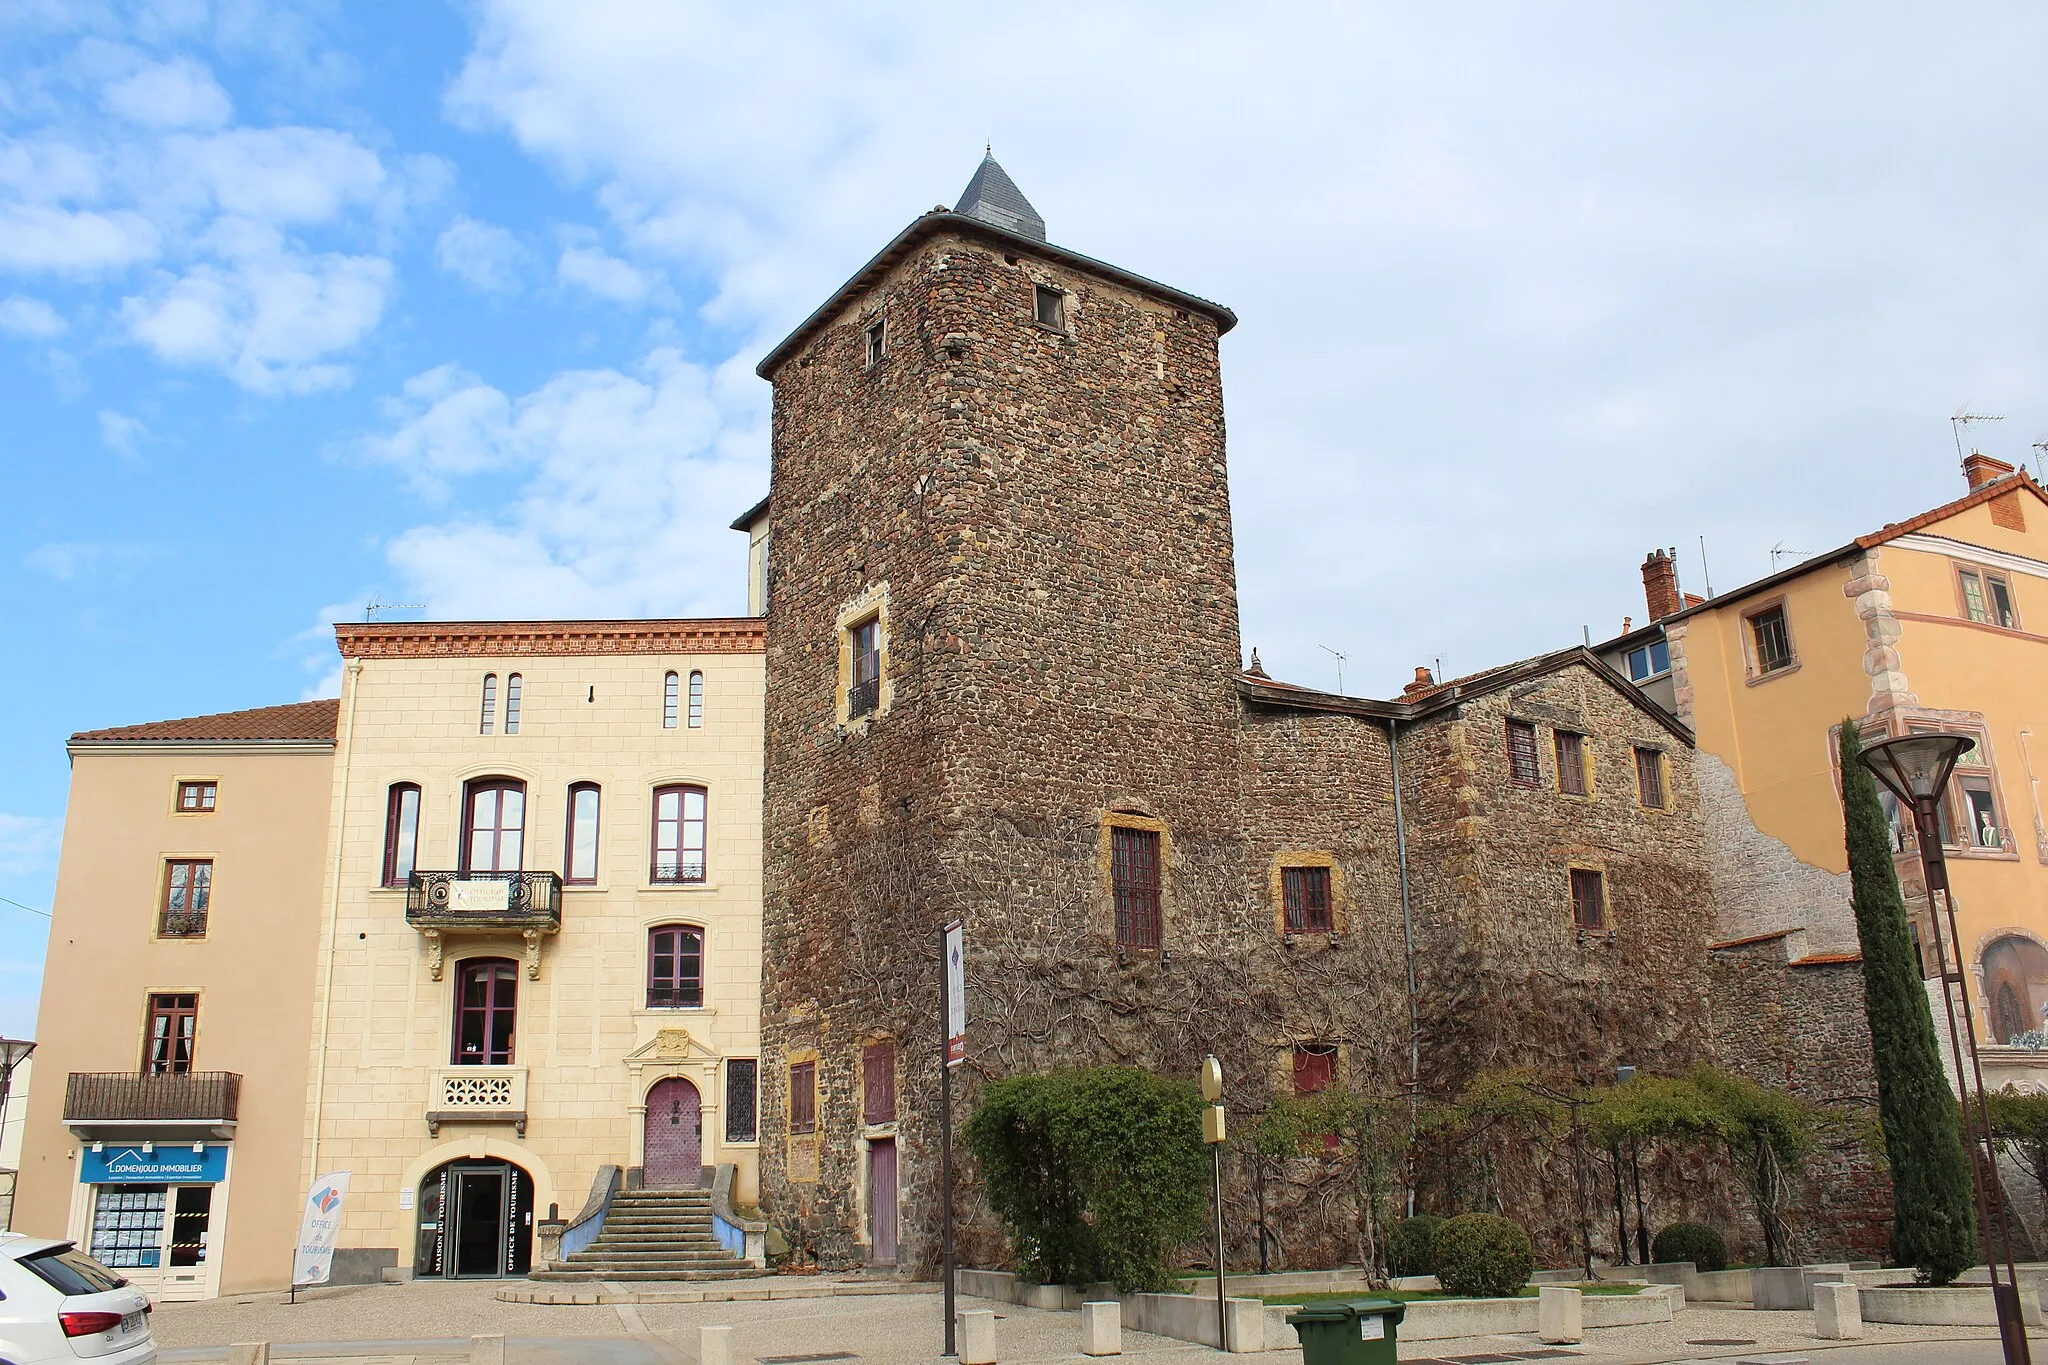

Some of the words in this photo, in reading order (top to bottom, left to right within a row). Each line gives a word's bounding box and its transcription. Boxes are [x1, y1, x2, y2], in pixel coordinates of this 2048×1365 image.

[159, 1164, 203, 1173] IMMOBILIER
[439, 1171, 447, 1218] TOURISME
[510, 1170, 518, 1219] TOURISME
[311, 1219, 332, 1229] OFFICE
[437, 1220, 444, 1234] DU
[509, 1221, 516, 1234] DE
[315, 1233, 323, 1242] de
[302, 1245, 332, 1255] TOURISME
[435, 1235, 443, 1272] MAISON
